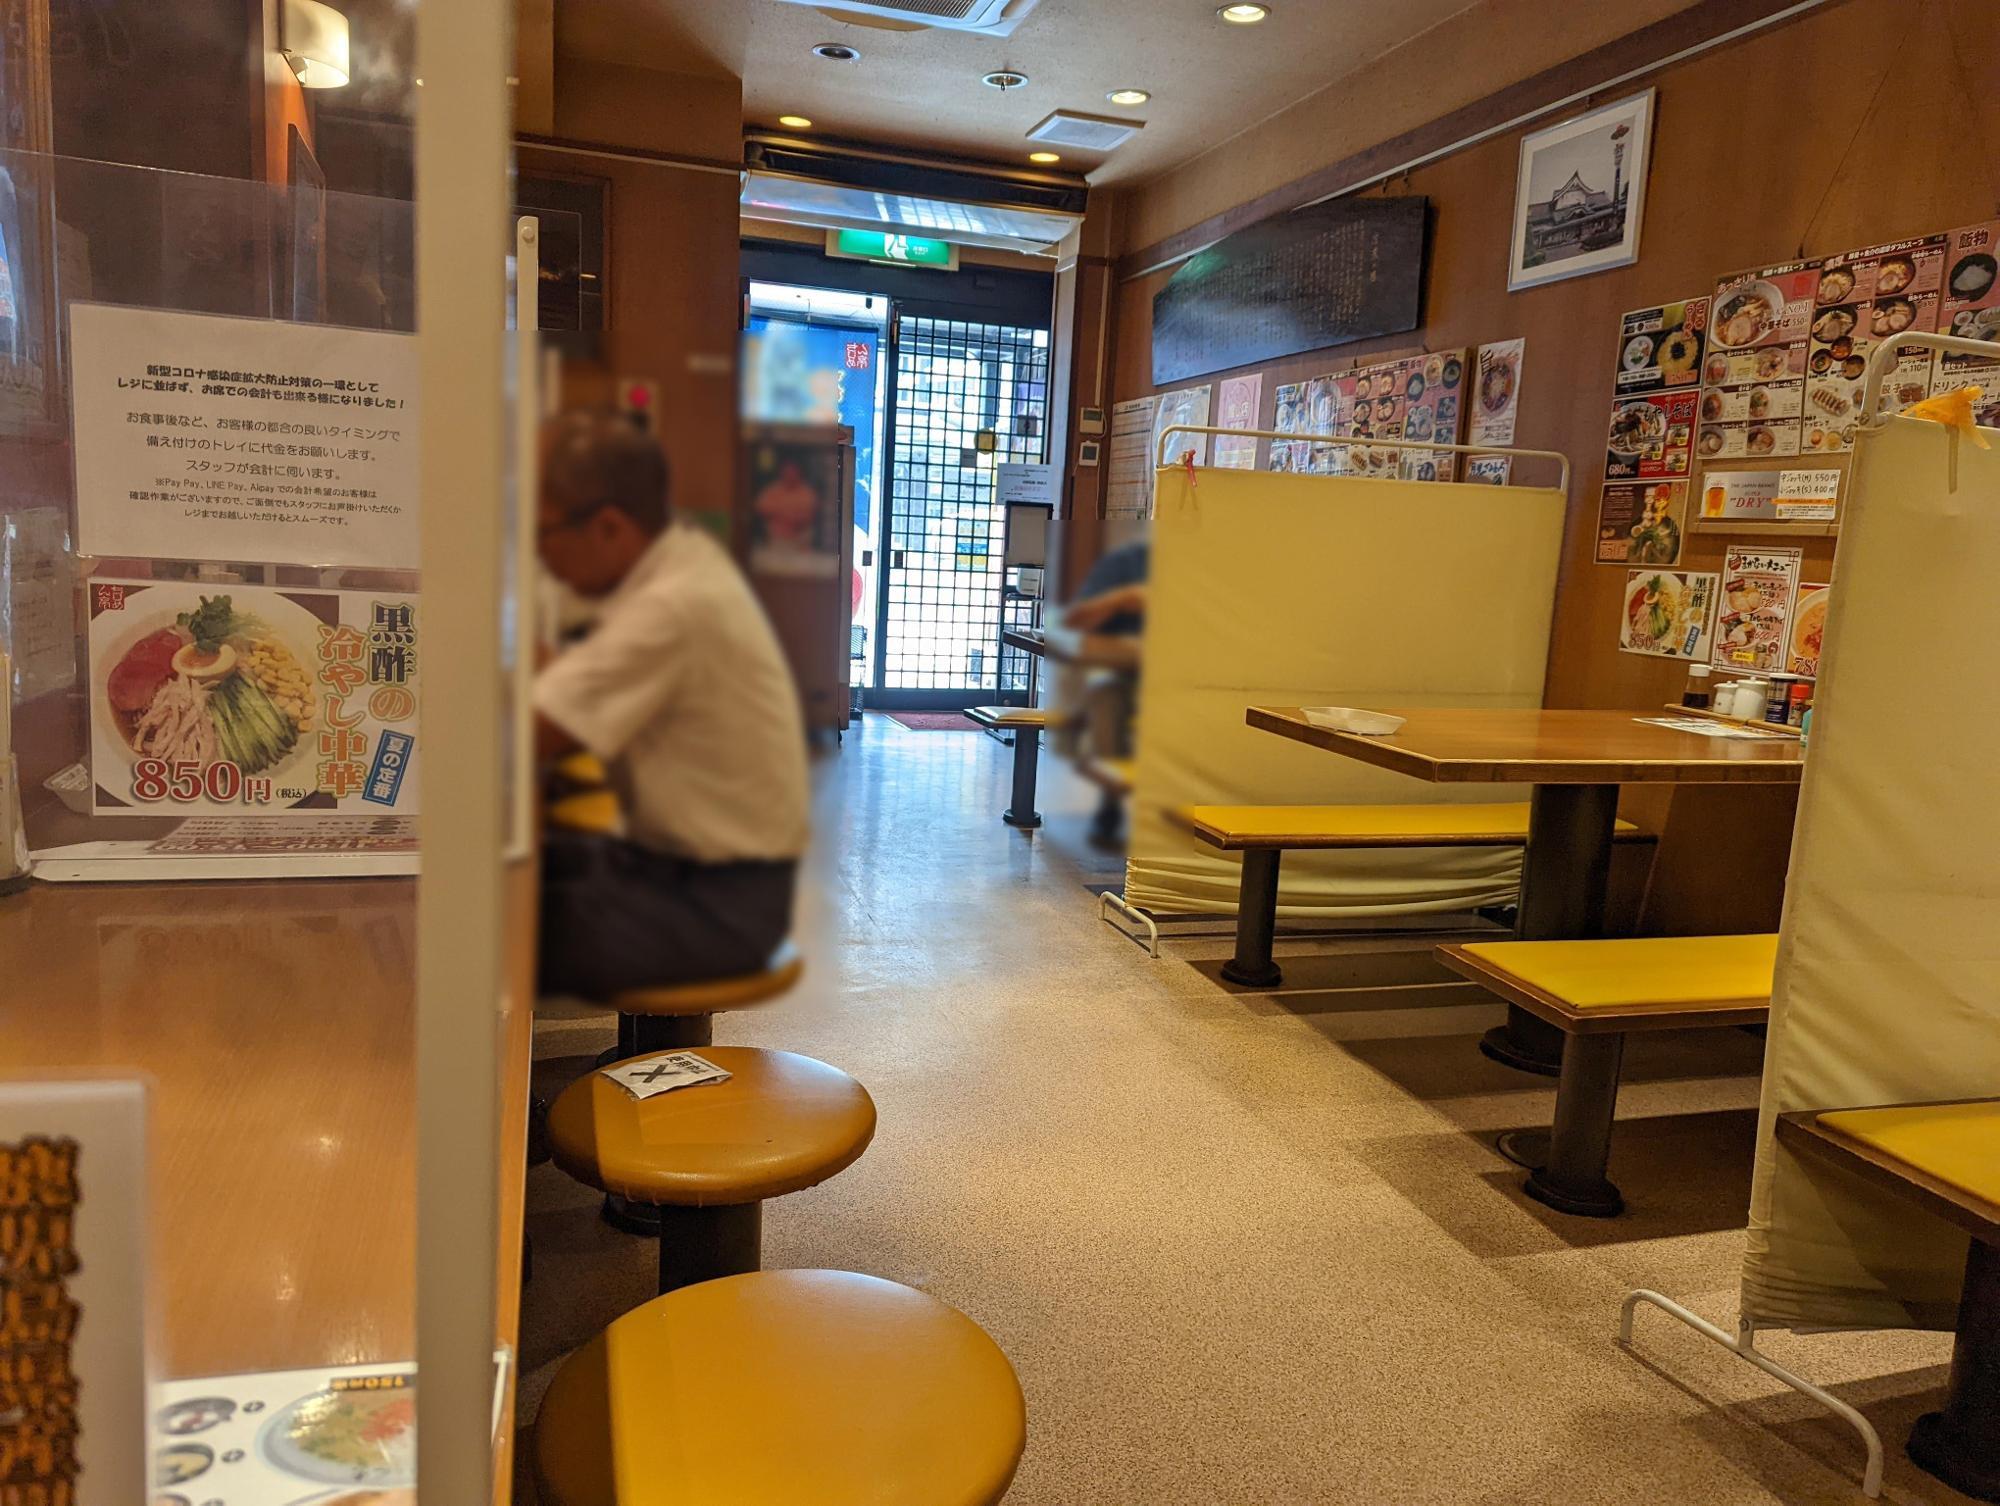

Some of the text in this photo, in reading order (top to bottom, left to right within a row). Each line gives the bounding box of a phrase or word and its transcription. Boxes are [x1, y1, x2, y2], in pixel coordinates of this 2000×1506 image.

[146, 364, 380, 394] 新型コロナ感染症拡大防止対策の一環として
[126, 411, 402, 442] お食事後など、お客様の都合の良いタイミングで
[146, 435, 377, 462] 備え付けのトレイに代金をお願いします。
[185, 459, 342, 481] スタッフが会計に伺います。
[369, 602, 415, 722] 黒酢の
[318, 624, 368, 798] 冷やし中華
